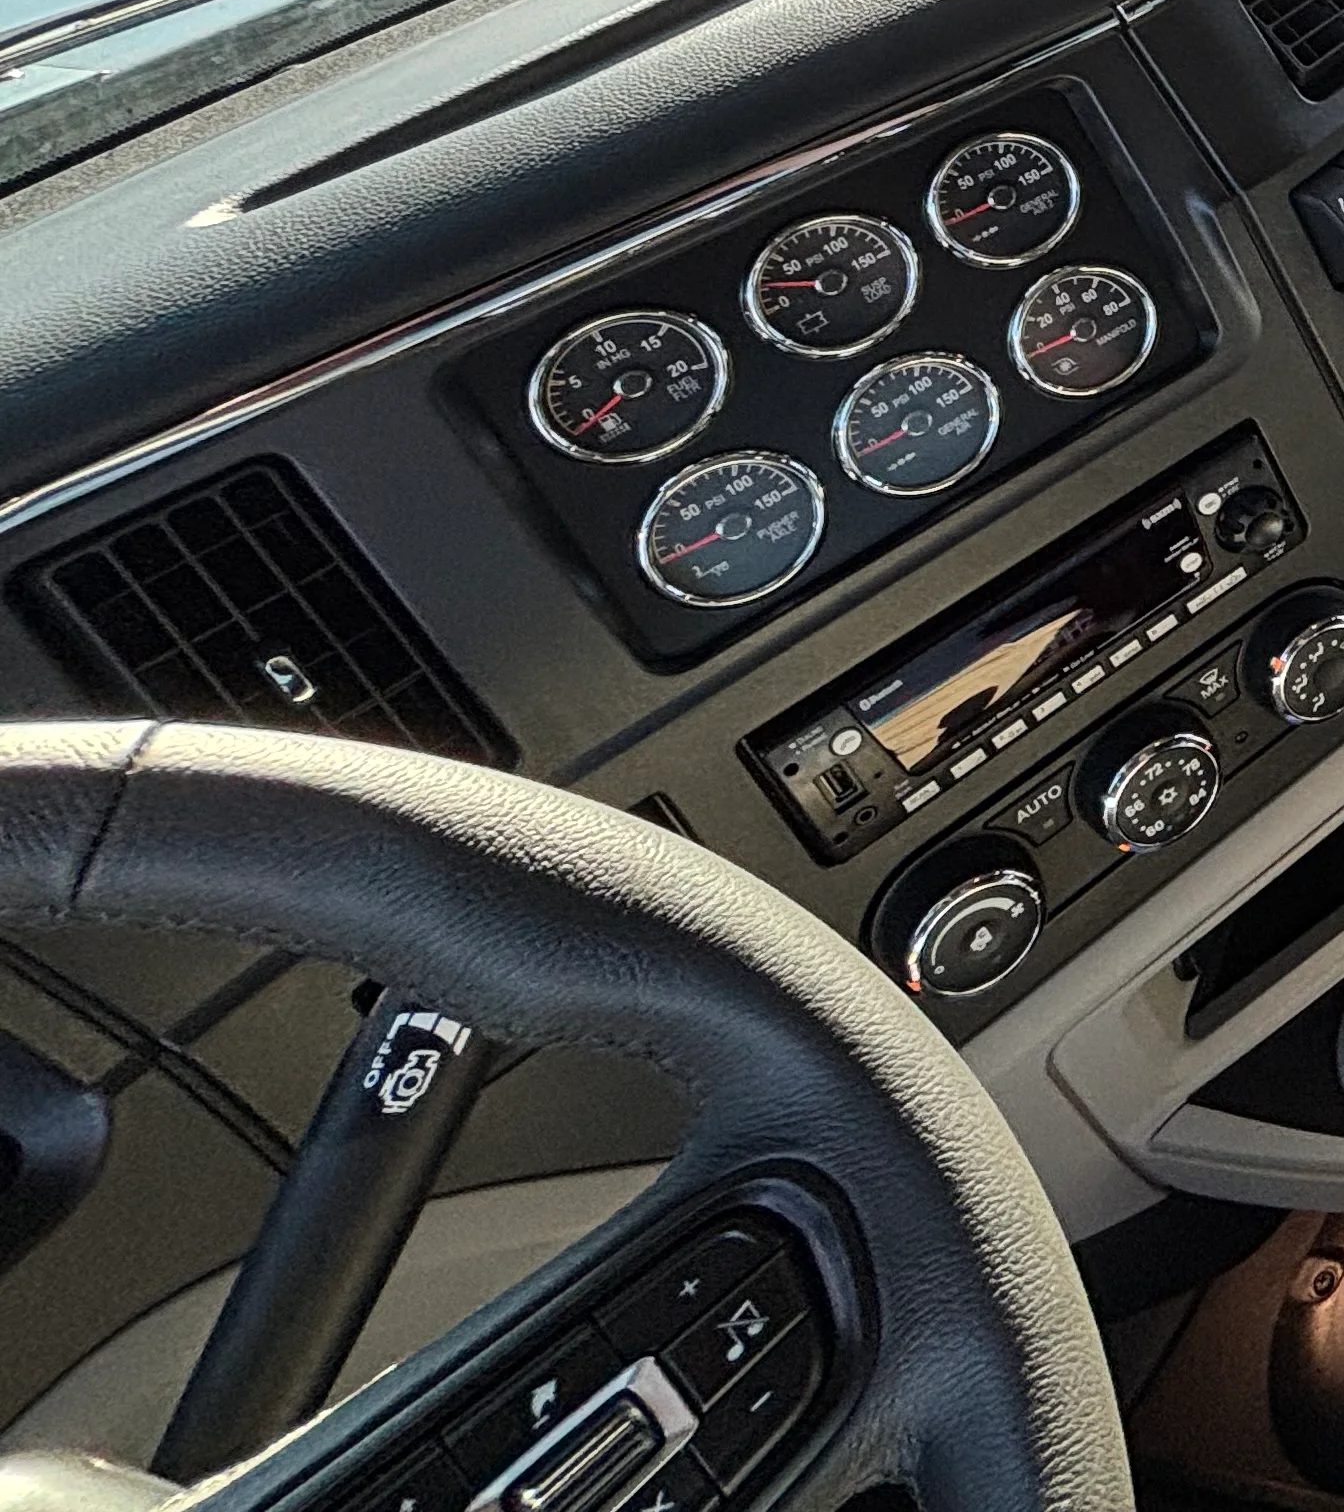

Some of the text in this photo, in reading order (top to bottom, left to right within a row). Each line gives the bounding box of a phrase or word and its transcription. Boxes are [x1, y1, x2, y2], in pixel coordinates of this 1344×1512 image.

[957, 153, 1041, 190] 50 PSI 100 150
[782, 236, 877, 275] 50 PSI 100 150
[778, 295, 791, 308] 0
[1036, 289, 1119, 328] 20 40 60 80
[1059, 302, 1076, 316] PSI
[1096, 318, 1137, 347] MANIFOLD
[568, 336, 688, 389] 5 10 15 20
[596, 349, 631, 371] IN HG
[871, 376, 960, 418] 50 PSI 100 150
[679, 474, 782, 521] 50 PSI 100 150
[756, 511, 800, 539] PUSHER
[1200, 674, 1229, 700] MAX
[1016, 784, 1063, 825] AUTO
[1124, 758, 1207, 838] 60 66 72 78 84
[363, 1041, 392, 1089] OFF
